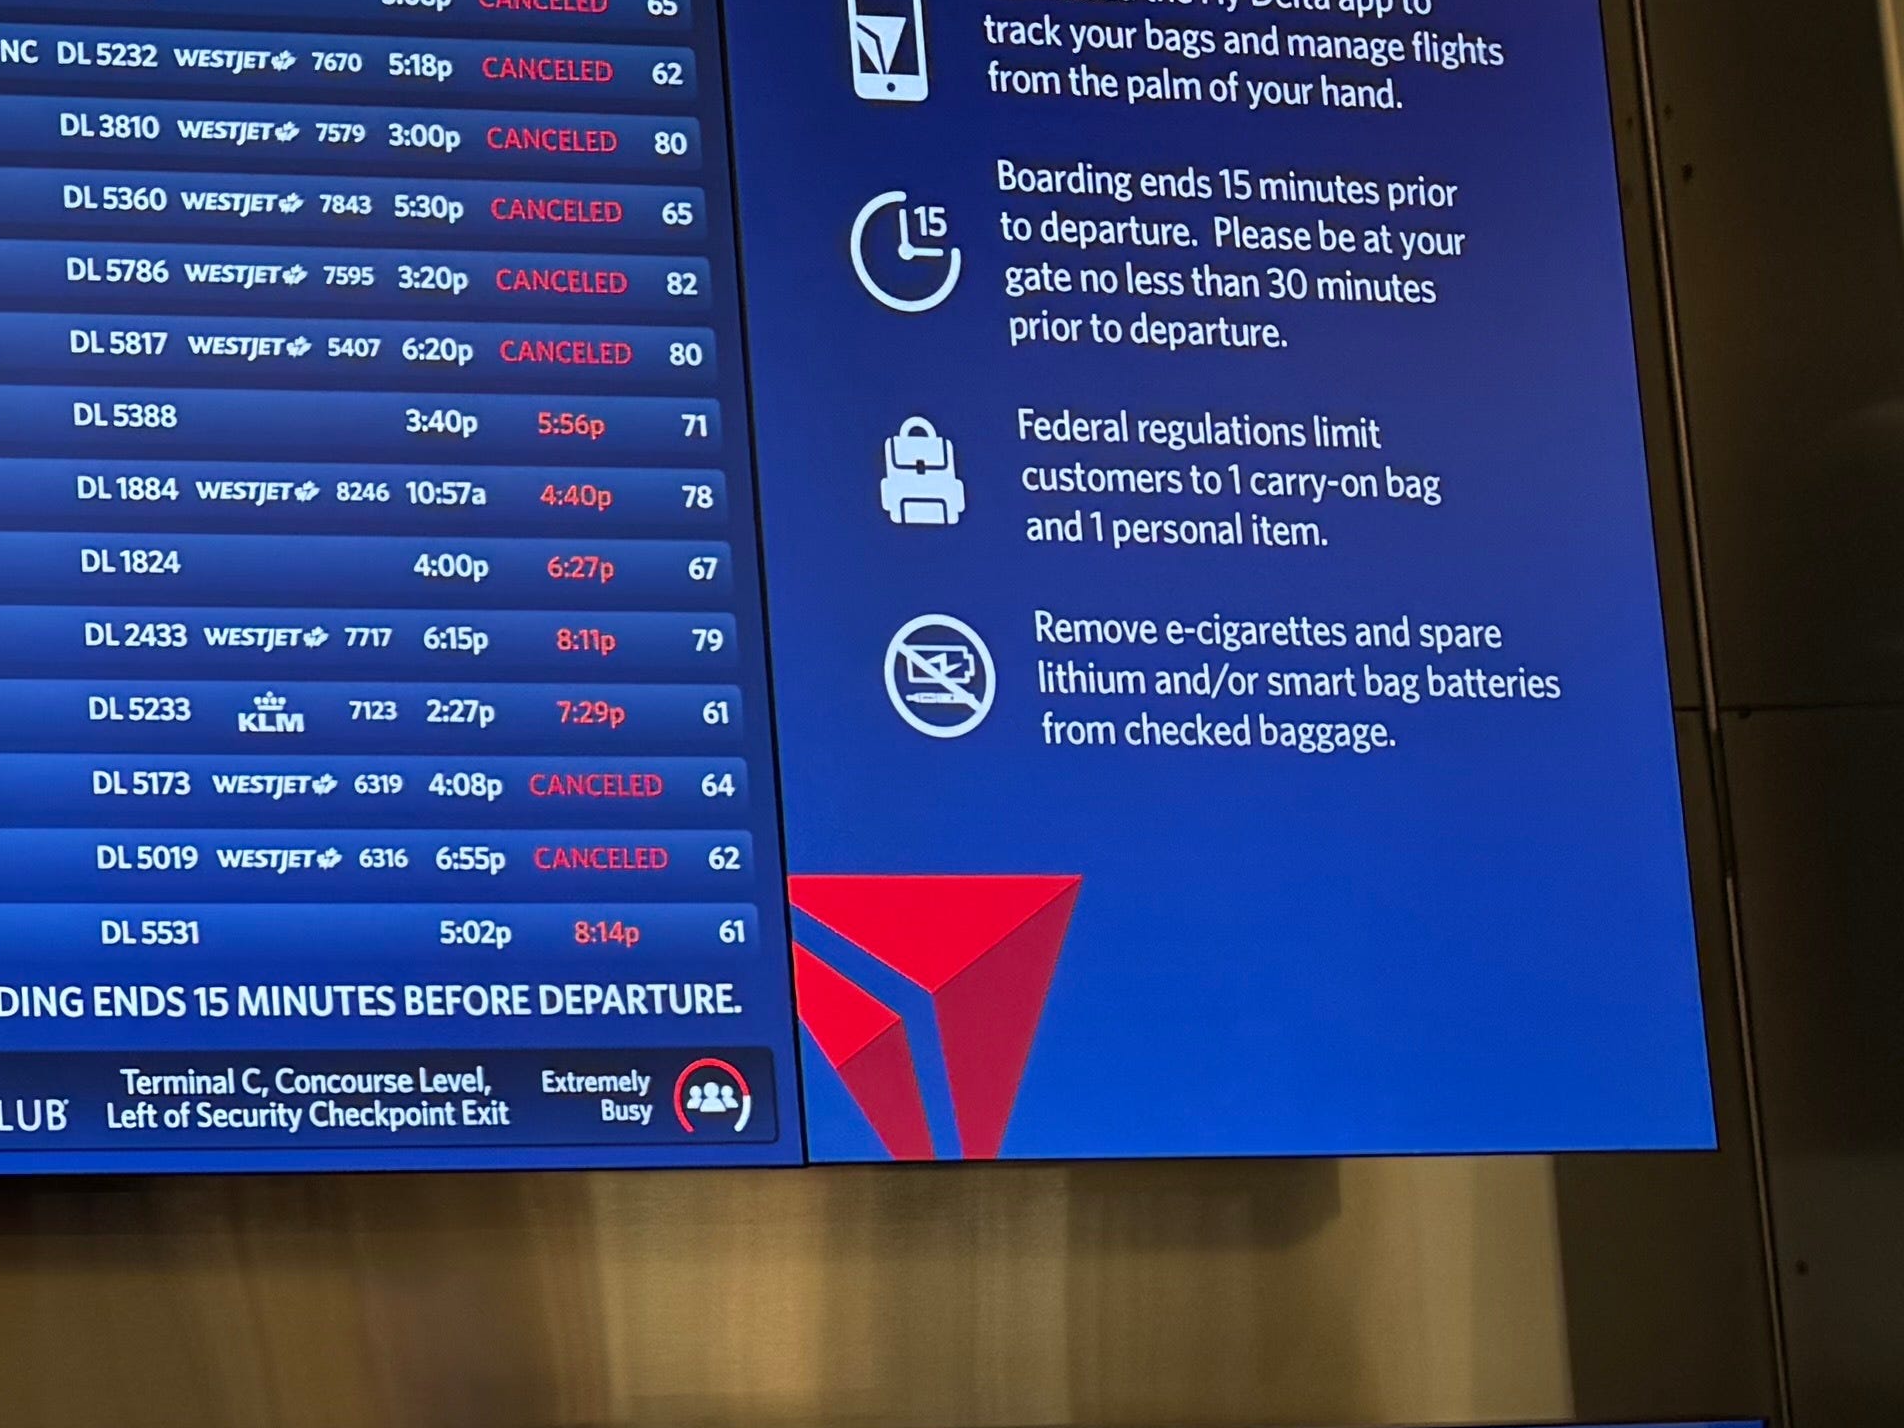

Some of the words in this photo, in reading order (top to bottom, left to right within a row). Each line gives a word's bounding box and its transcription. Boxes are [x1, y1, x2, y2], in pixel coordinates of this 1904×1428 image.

[914, 206, 947, 237] 15
[1018, 408, 1128, 442] Federal
[1138, 412, 1306, 450] regulations
[1314, 415, 1381, 448] limit
[89, 697, 123, 720] DL
[129, 697, 191, 721] 5233
[238, 713, 304, 732] KLM
[349, 701, 397, 720] 7123
[427, 699, 495, 728] 2:27p
[557, 700, 625, 729] 7:29p
[703, 701, 728, 724] 61
[1042, 711, 1116, 745] from
[1125, 712, 1251, 746] checked
[1259, 713, 1395, 753] baggage.
